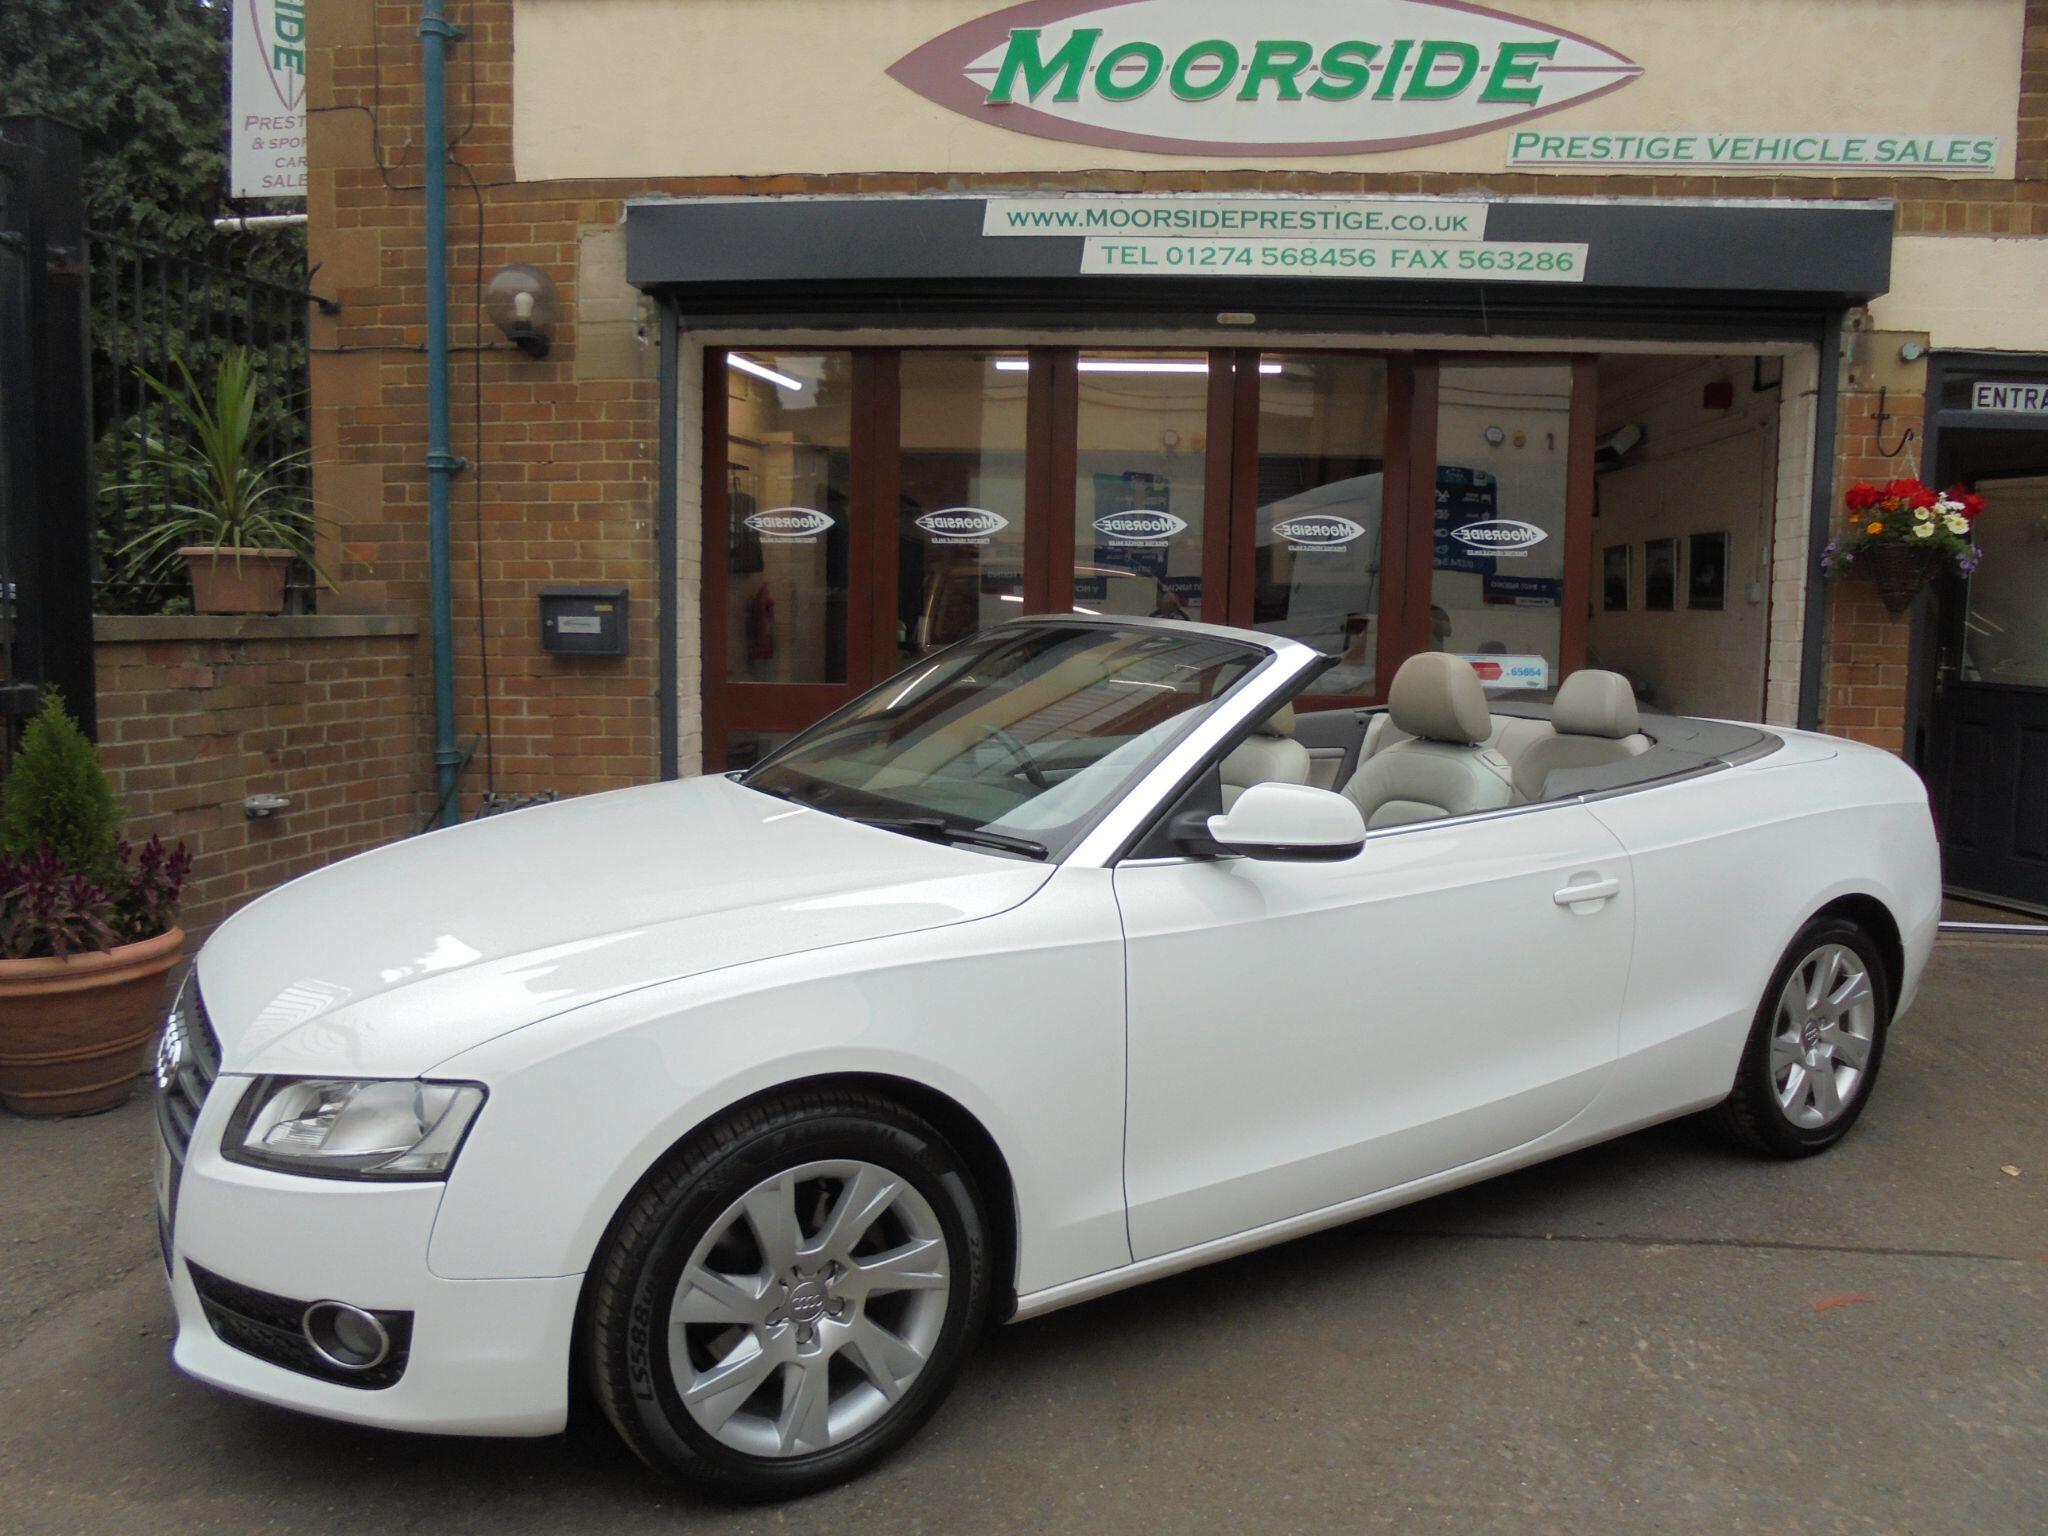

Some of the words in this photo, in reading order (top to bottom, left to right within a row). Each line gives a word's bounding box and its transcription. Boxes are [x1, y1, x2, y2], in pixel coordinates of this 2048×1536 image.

[985, 28, 1561, 106] MOORSIDE
[244, 116, 307, 131] PREST
[252, 137, 264, 150] &
[1512, 132, 1697, 161] PRESTIGE
[1707, 137, 1867, 163] VEHICLE
[1873, 139, 1994, 164] SALES
[275, 157, 308, 169] CAR
[262, 174, 308, 188] SALE
[1007, 209, 1468, 231] WWW.MOORSIDEPRESTIGE.CO.UK
[1101, 246, 1157, 264] TEL
[1166, 247, 1252, 266] 01274
[1261, 248, 1376, 267] 568456
[1391, 250, 1448, 268] FAX
[1458, 250, 1574, 271] 563286
[1977, 387, 2048, 409] ENTRA
